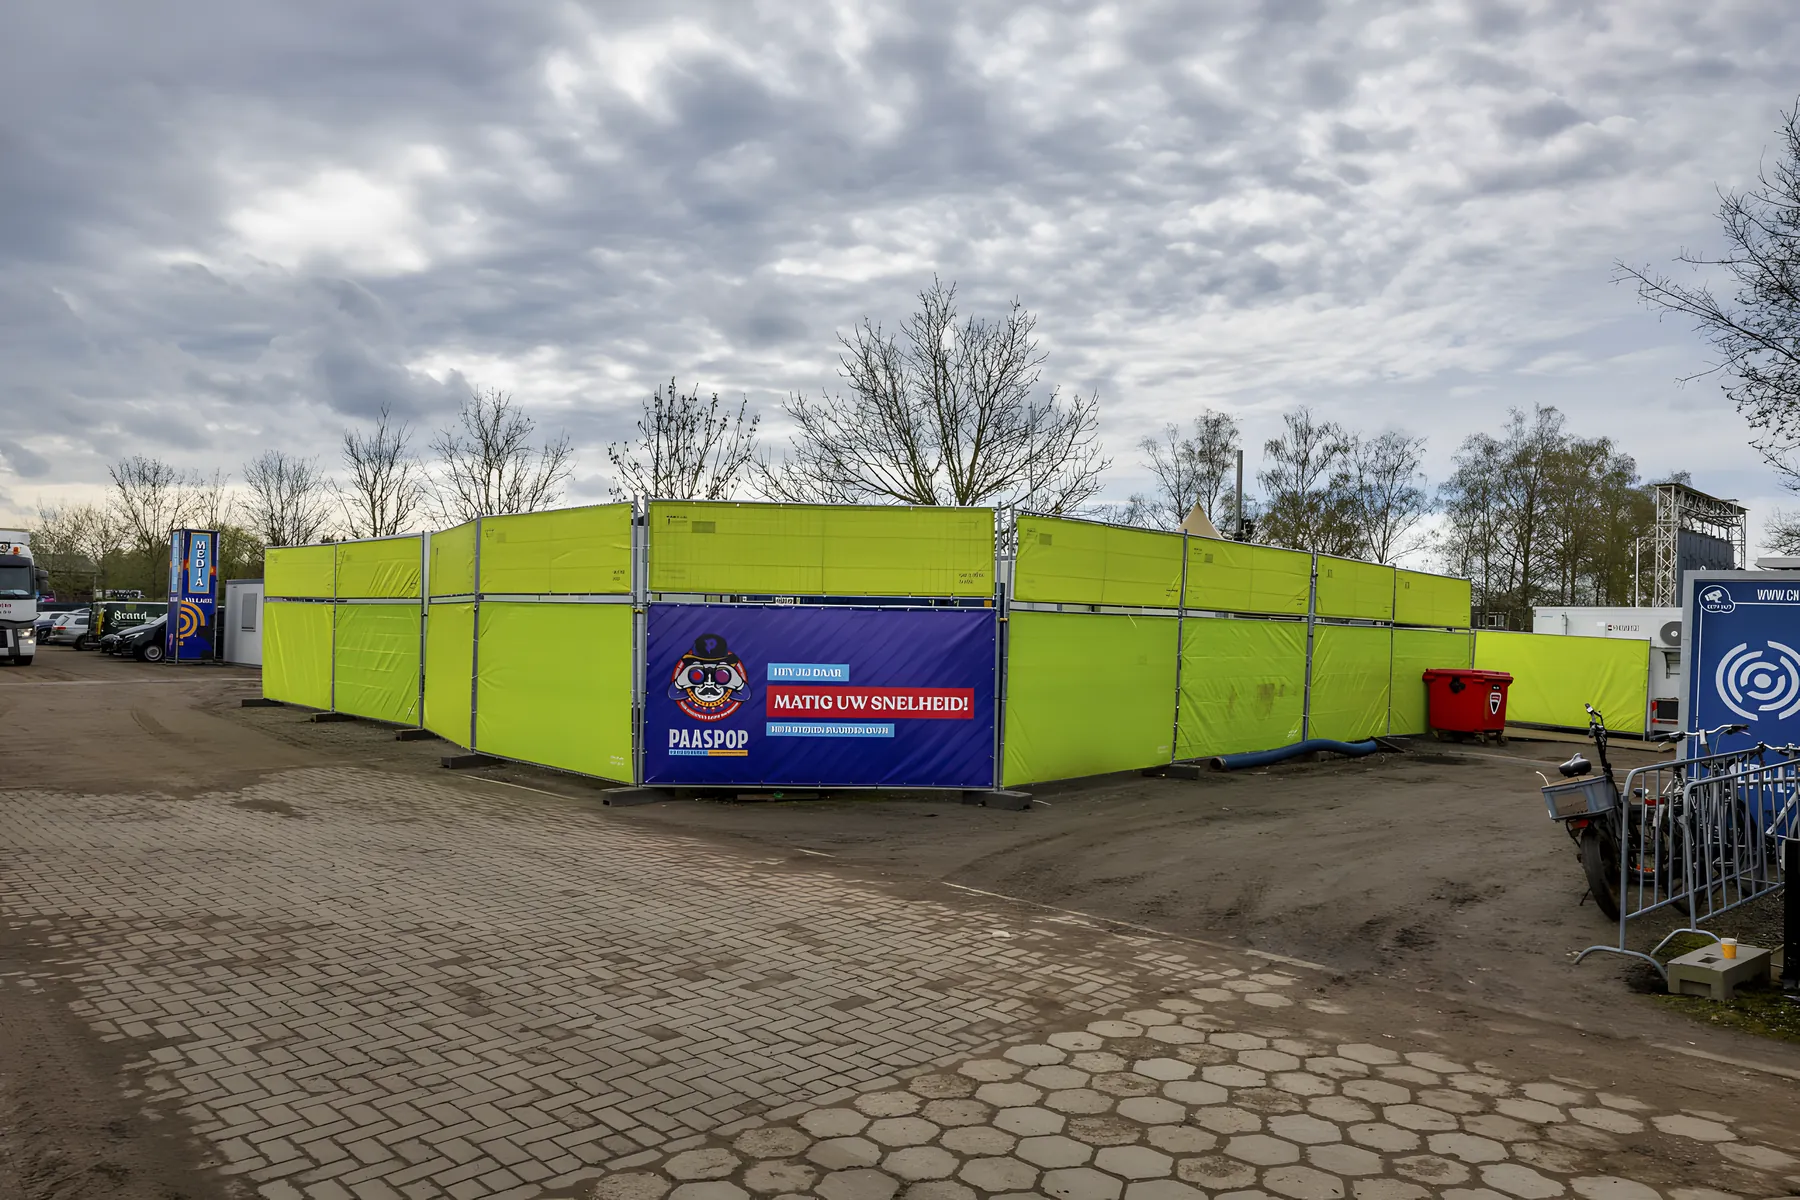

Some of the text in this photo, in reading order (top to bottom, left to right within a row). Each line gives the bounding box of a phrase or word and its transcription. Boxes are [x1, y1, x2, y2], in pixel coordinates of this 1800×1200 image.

[195, 540, 206, 587] MEDIA
[114, 610, 147, 620] Brand
[774, 695, 969, 711] MATIG UW SNELHEID!
[668, 729, 749, 748] PAASPOP
